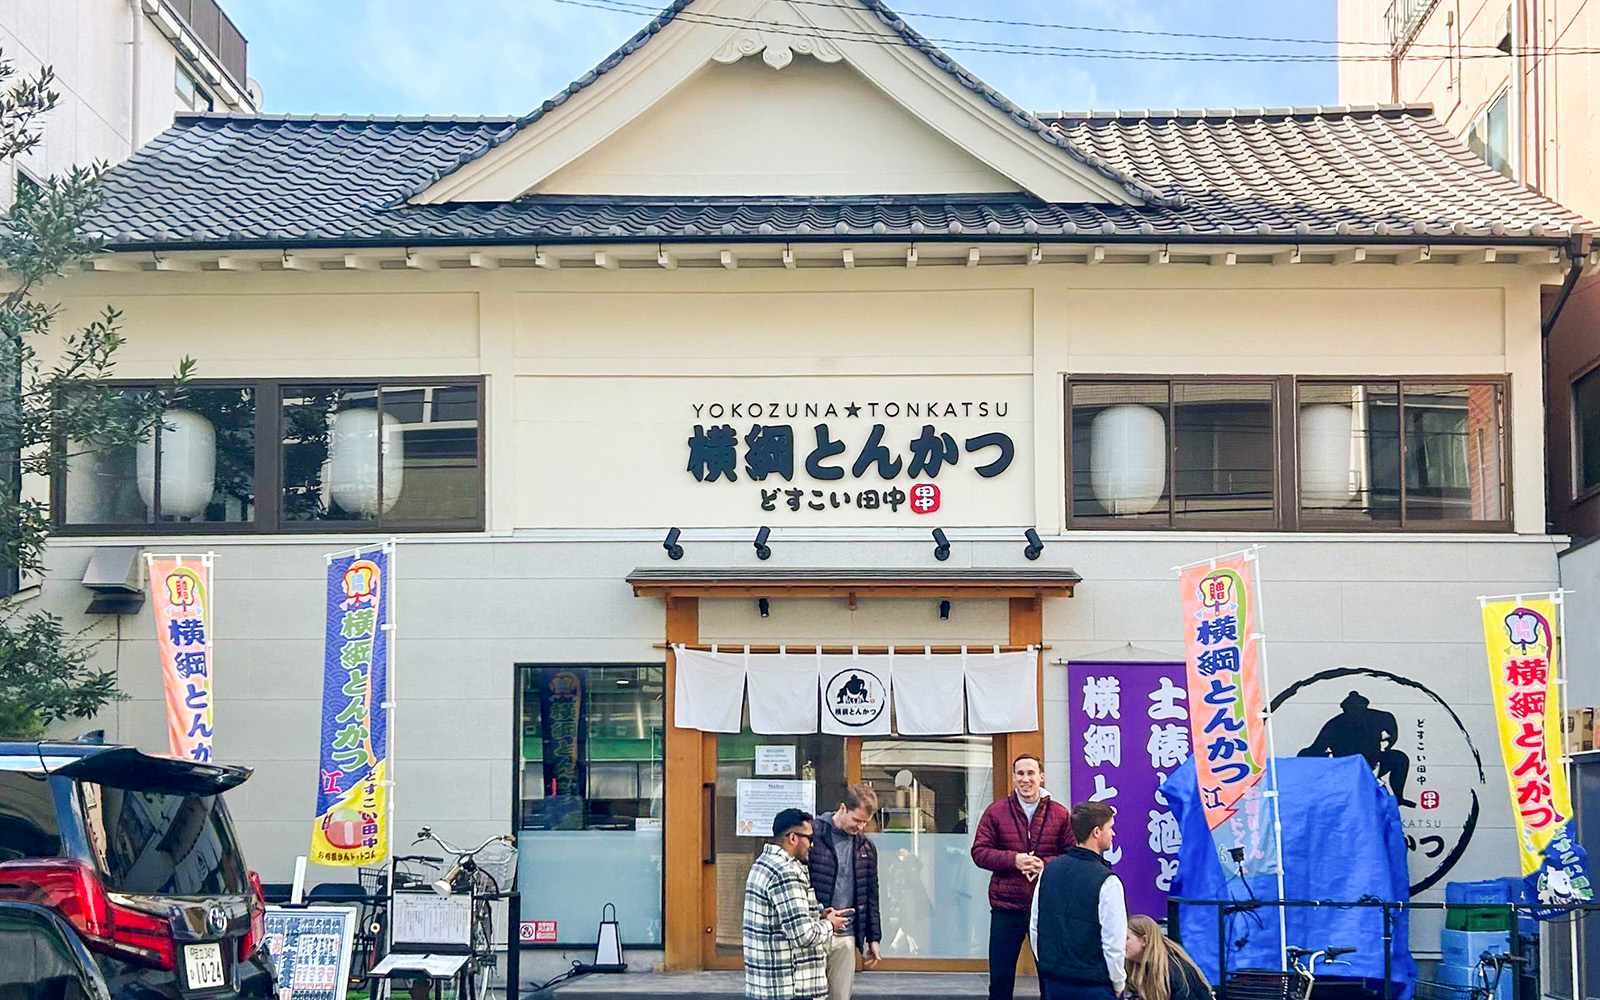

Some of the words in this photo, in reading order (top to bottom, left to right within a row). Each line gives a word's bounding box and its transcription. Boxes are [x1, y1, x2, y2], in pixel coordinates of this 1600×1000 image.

[686, 423, 1015, 483] 横綱とんかつ
[692, 402, 839, 419] YOKOZUNA
[867, 401, 1009, 418] TONKATSU
[332, 607, 375, 772] 横綱とんかつ
[1196, 614, 1250, 784] 横綱とんかつ
[1506, 657, 1553, 828] 横綱とんかつ
